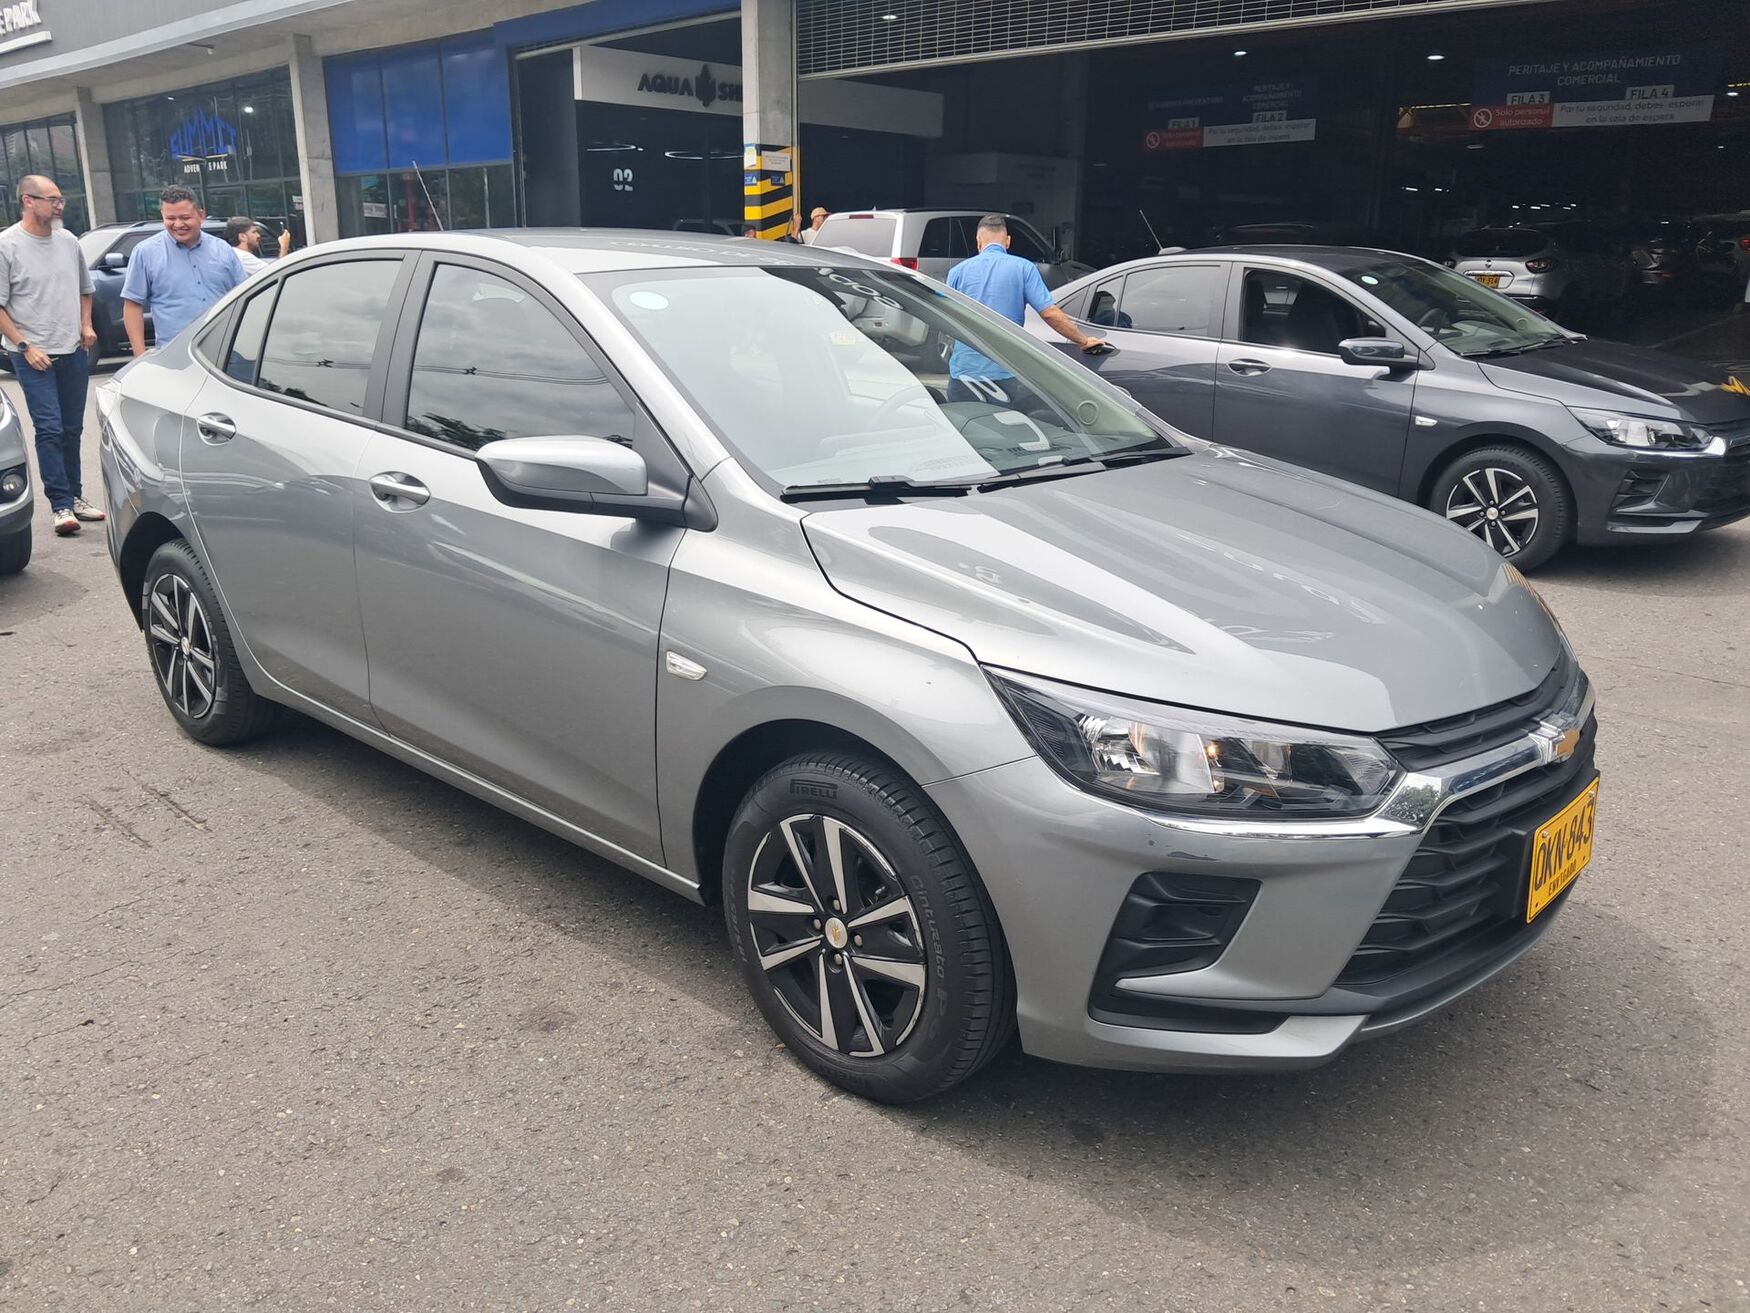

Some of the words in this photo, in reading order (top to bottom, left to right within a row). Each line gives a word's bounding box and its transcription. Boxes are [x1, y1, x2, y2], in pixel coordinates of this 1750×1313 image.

[3, 0, 42, 32] PARK
[1508, 62, 1561, 76] PERITAJE
[637, 73, 694, 97] AQUA
[717, 82, 743, 102] SH
[1557, 73, 1620, 87] COMERCIAL
[1511, 94, 1536, 105] FILA
[1538, 93, 1546, 104] 3
[1631, 88, 1657, 100] FILA
[1661, 88, 1669, 97] 4
[612, 168, 634, 192] 02
[790, 779, 838, 800] PIRELLI
